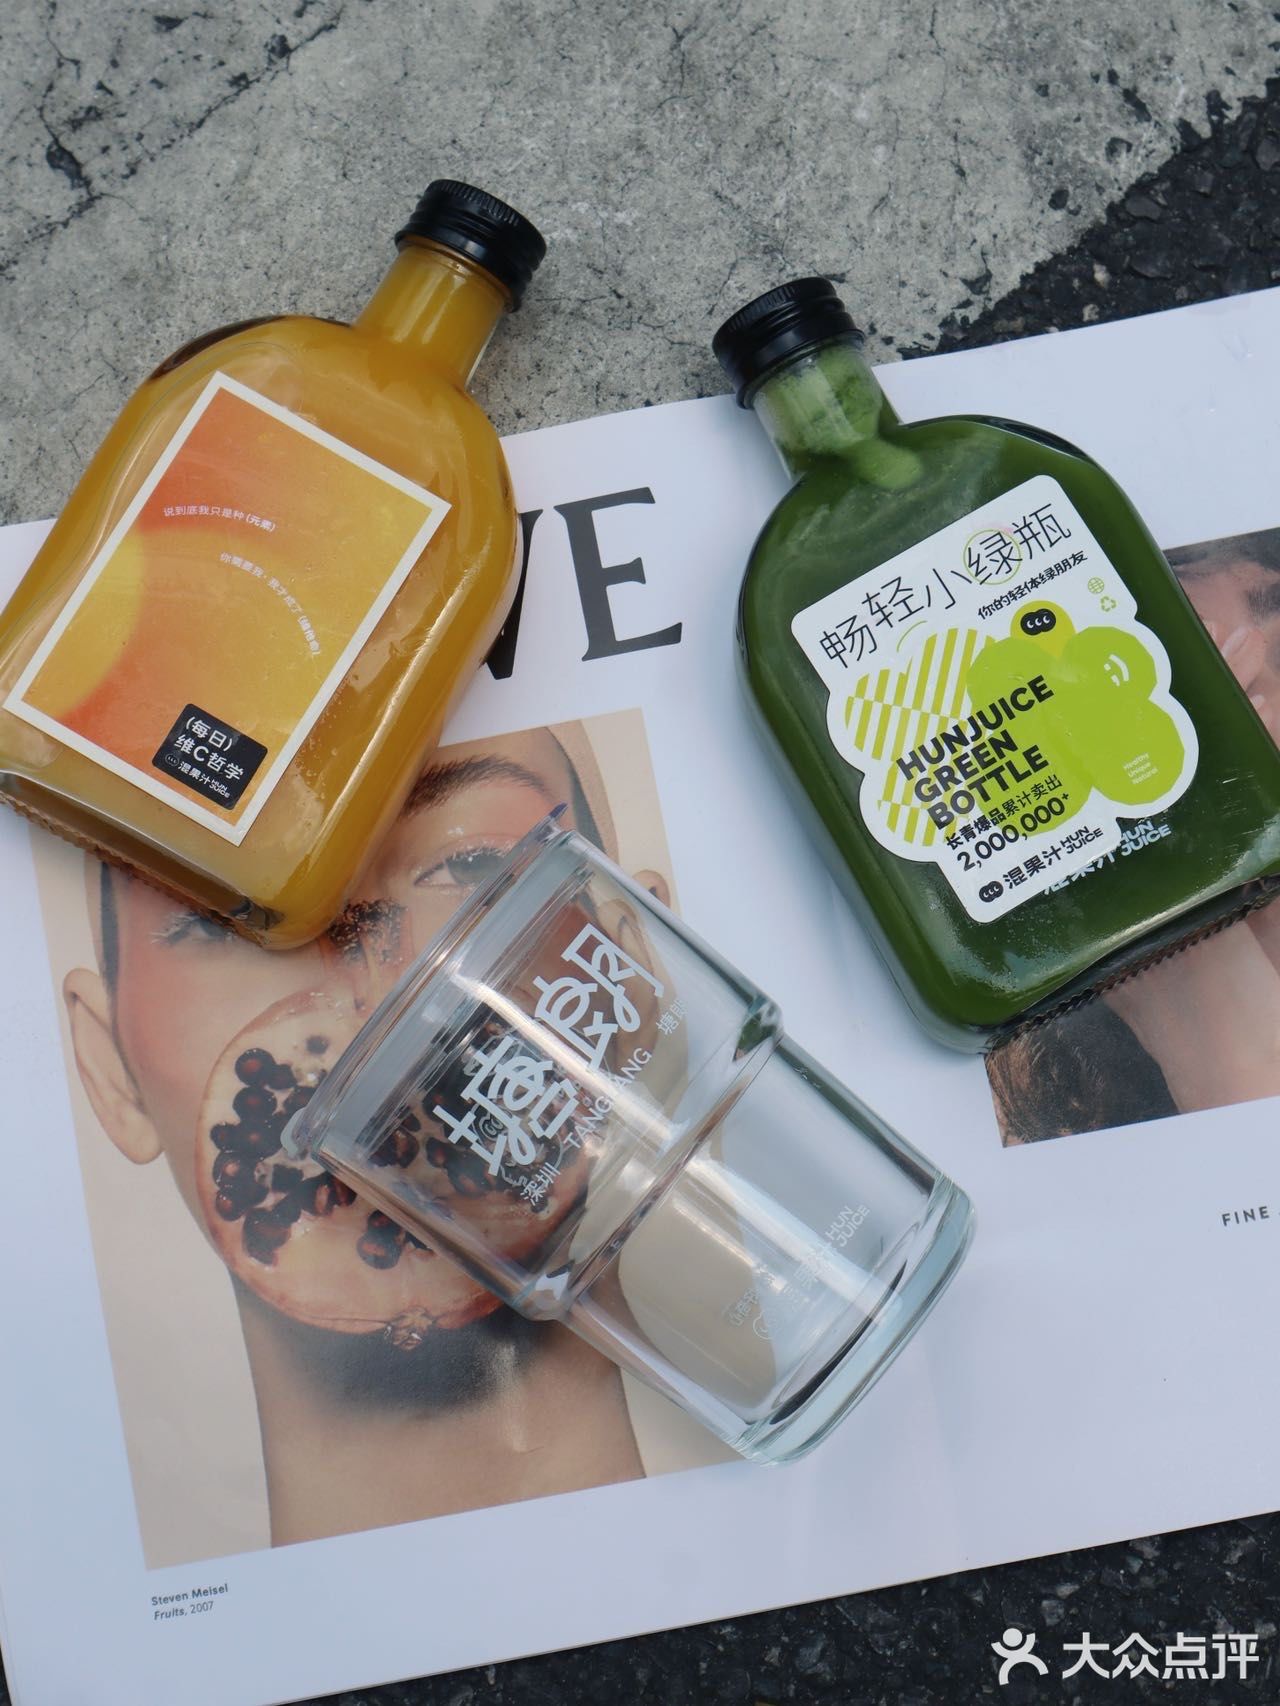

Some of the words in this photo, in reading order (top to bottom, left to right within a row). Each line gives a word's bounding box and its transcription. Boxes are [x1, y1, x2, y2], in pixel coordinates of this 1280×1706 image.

[819, 503, 1072, 669] 畅轻小绿瓶
[977, 550, 1088, 620] 你的轻体绿朋友
[185, 716, 233, 752] (每日)
[895, 675, 1055, 781] HUNJUICE
[174, 734, 244, 780] 维C哲学
[177, 761, 211, 785] 混果汁
[913, 729, 1019, 803] GREEN
[927, 744, 1049, 830] BOTTLE
[945, 774, 1063, 850] 长青爆品累计卖出
[957, 793, 1070, 873] 2,000,000+
[1060, 825, 1090, 847] HUN
[1066, 827, 1104, 855] JUICE
[1120, 824, 1172, 856] JUICE
[1002, 844, 1062, 889] 混果汁
[519, 1162, 561, 1207] 深圳
[825, 1205, 854, 1241] HUN
[836, 1203, 870, 1248] JUICE
[1222, 1206, 1270, 1227] FINE
[151, 1593, 189, 1606] Steven
[191, 1583, 228, 1599] Meisel
[154, 1608, 188, 1621] Fruits,
[190, 1600, 214, 1614] 2007
